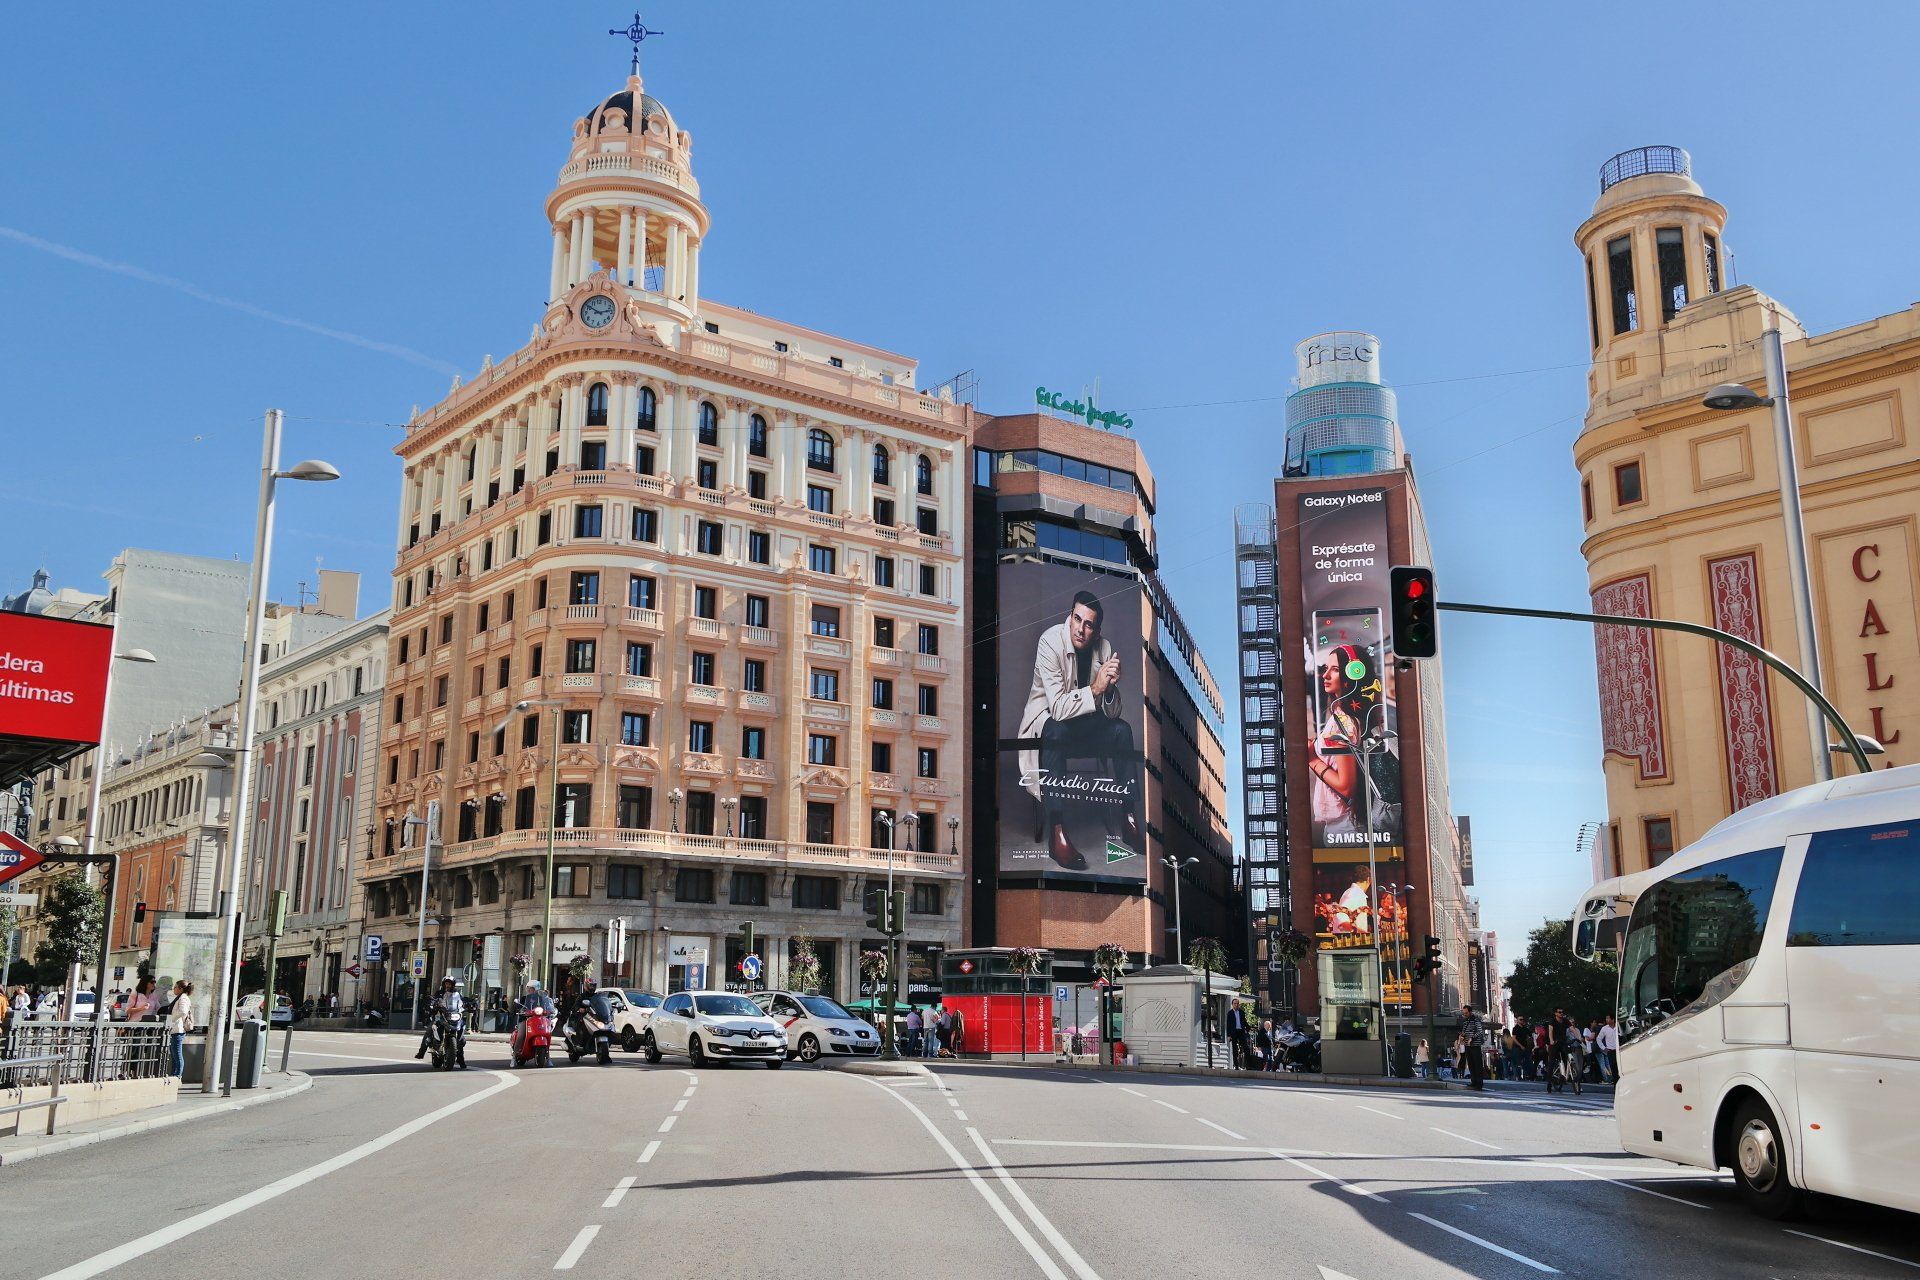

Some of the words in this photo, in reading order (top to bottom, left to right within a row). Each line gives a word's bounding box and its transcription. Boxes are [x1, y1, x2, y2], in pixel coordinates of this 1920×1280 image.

[1306, 344, 1374, 368] fnac
[1304, 496, 1346, 507] Galaxy
[1347, 492, 1382, 504] Note8
[1312, 542, 1376, 557] Exprésate
[1315, 559, 1332, 570] de
[1334, 557, 1374, 569] forma
[1328, 572, 1362, 583] única
[1852, 544, 1900, 769] CALL
[367, 936, 381, 955] P
[908, 983, 929, 994] pans
[1057, 987, 1066, 998] P
[1039, 1021, 1044, 1031] de
